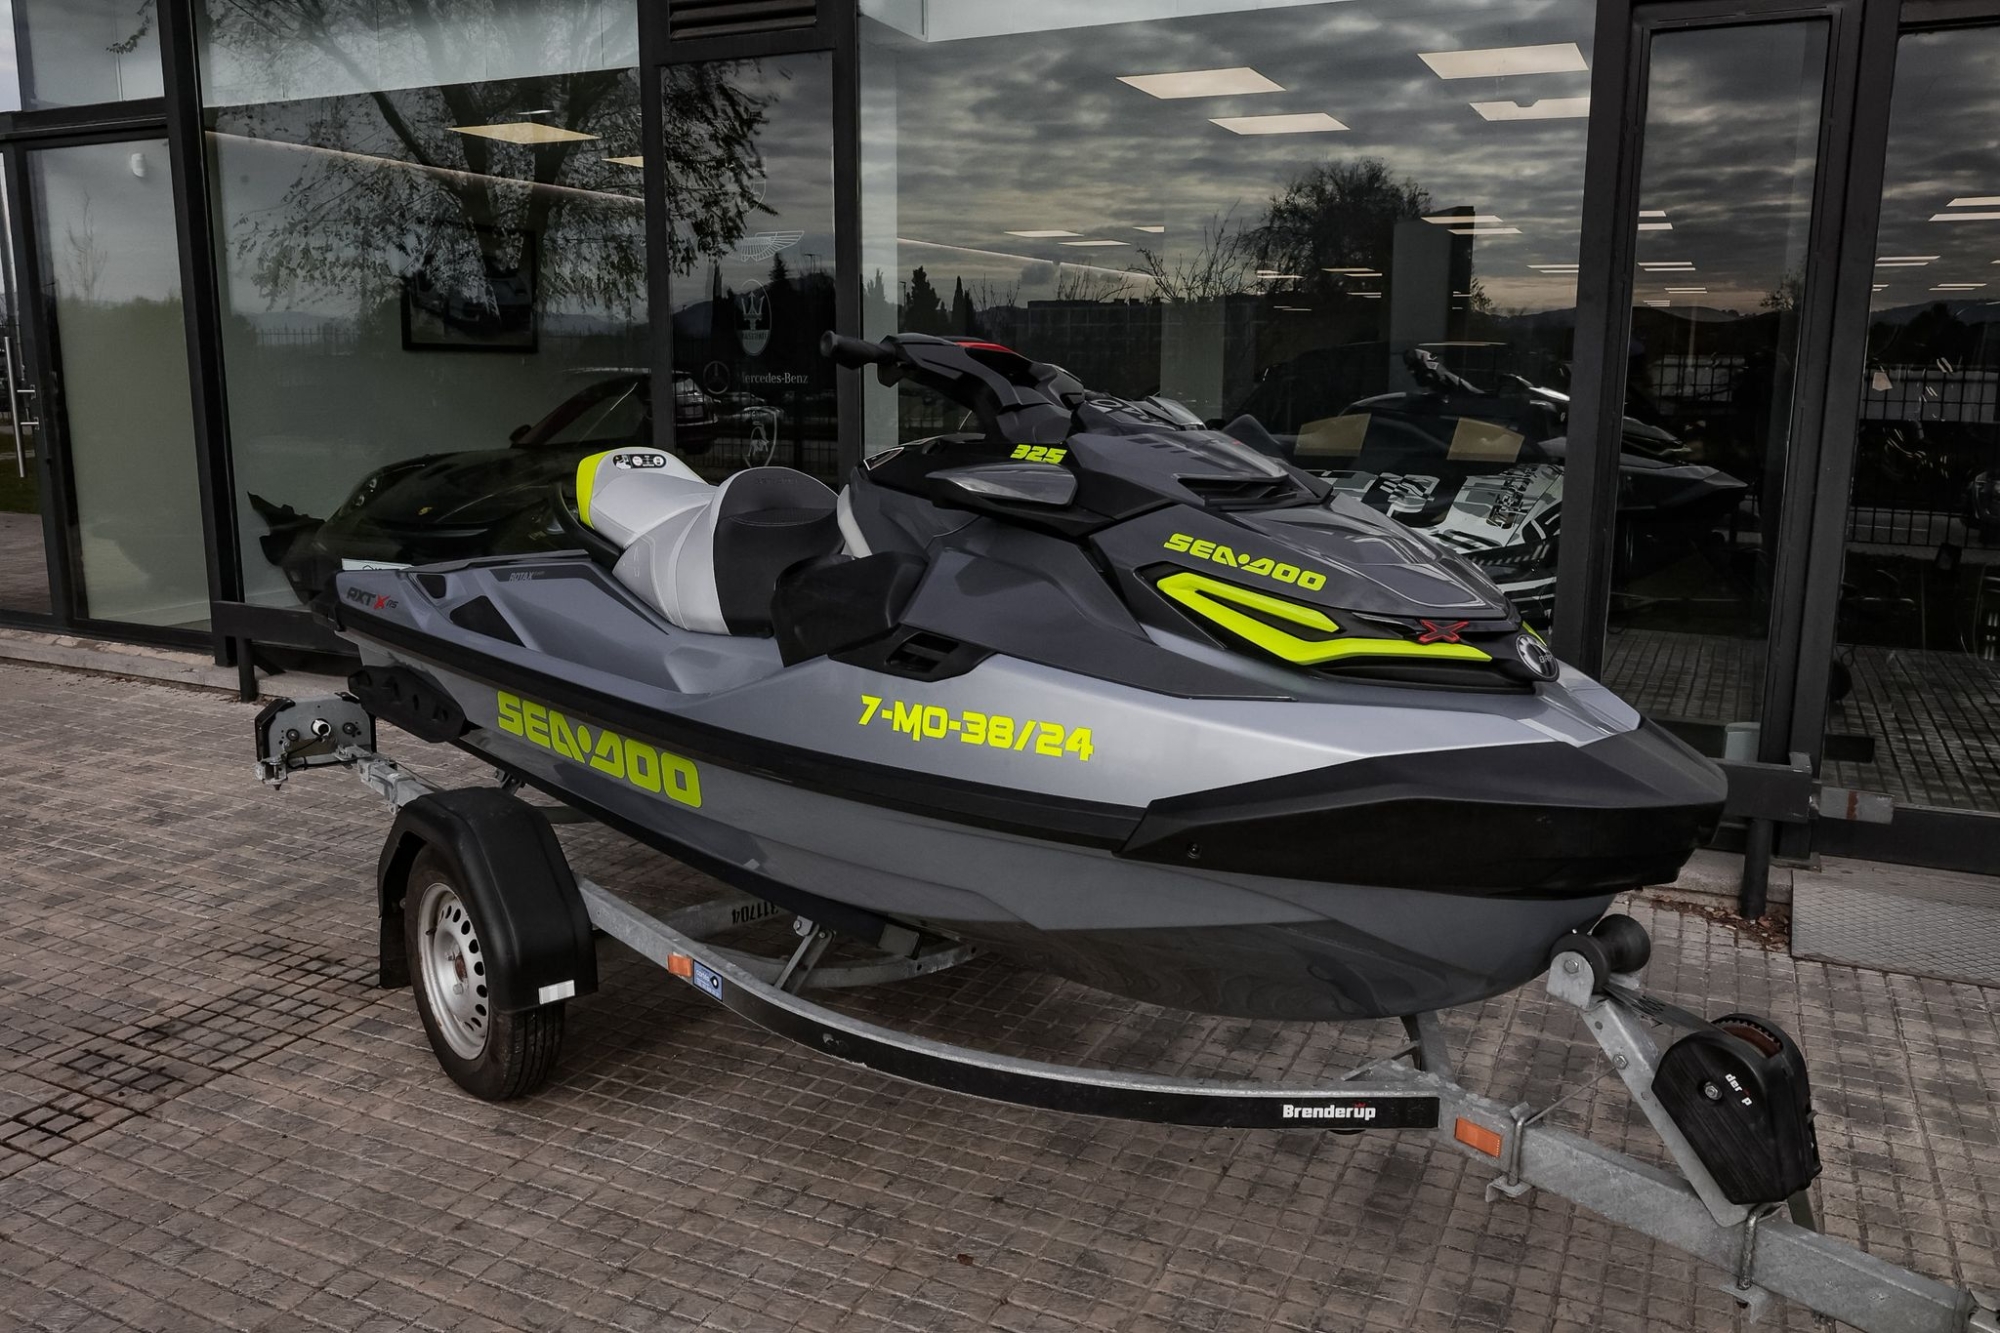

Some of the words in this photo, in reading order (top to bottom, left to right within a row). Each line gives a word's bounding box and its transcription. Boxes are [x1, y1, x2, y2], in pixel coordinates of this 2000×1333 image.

[1010, 443, 1068, 465] 325
[858, 695, 1095, 761] 7-MO-38/24
[1282, 1104, 1377, 1121] Brenderup
